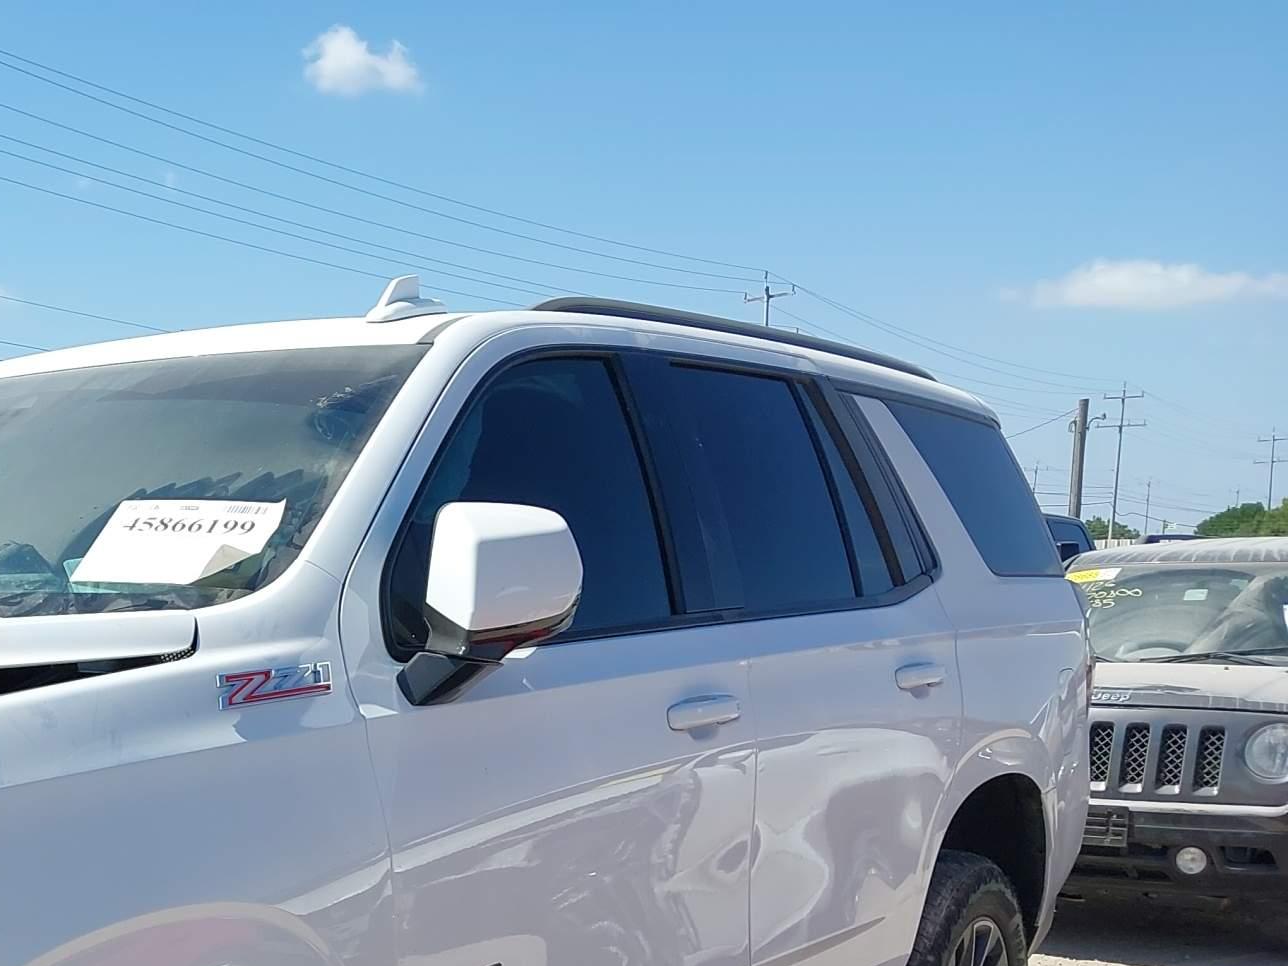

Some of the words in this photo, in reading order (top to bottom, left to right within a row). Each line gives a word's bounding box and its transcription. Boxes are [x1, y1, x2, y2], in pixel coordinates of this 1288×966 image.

[122, 517, 256, 535] 45866199
[216, 661, 332, 711] Z71
[1091, 690, 1132, 702] Jeep
